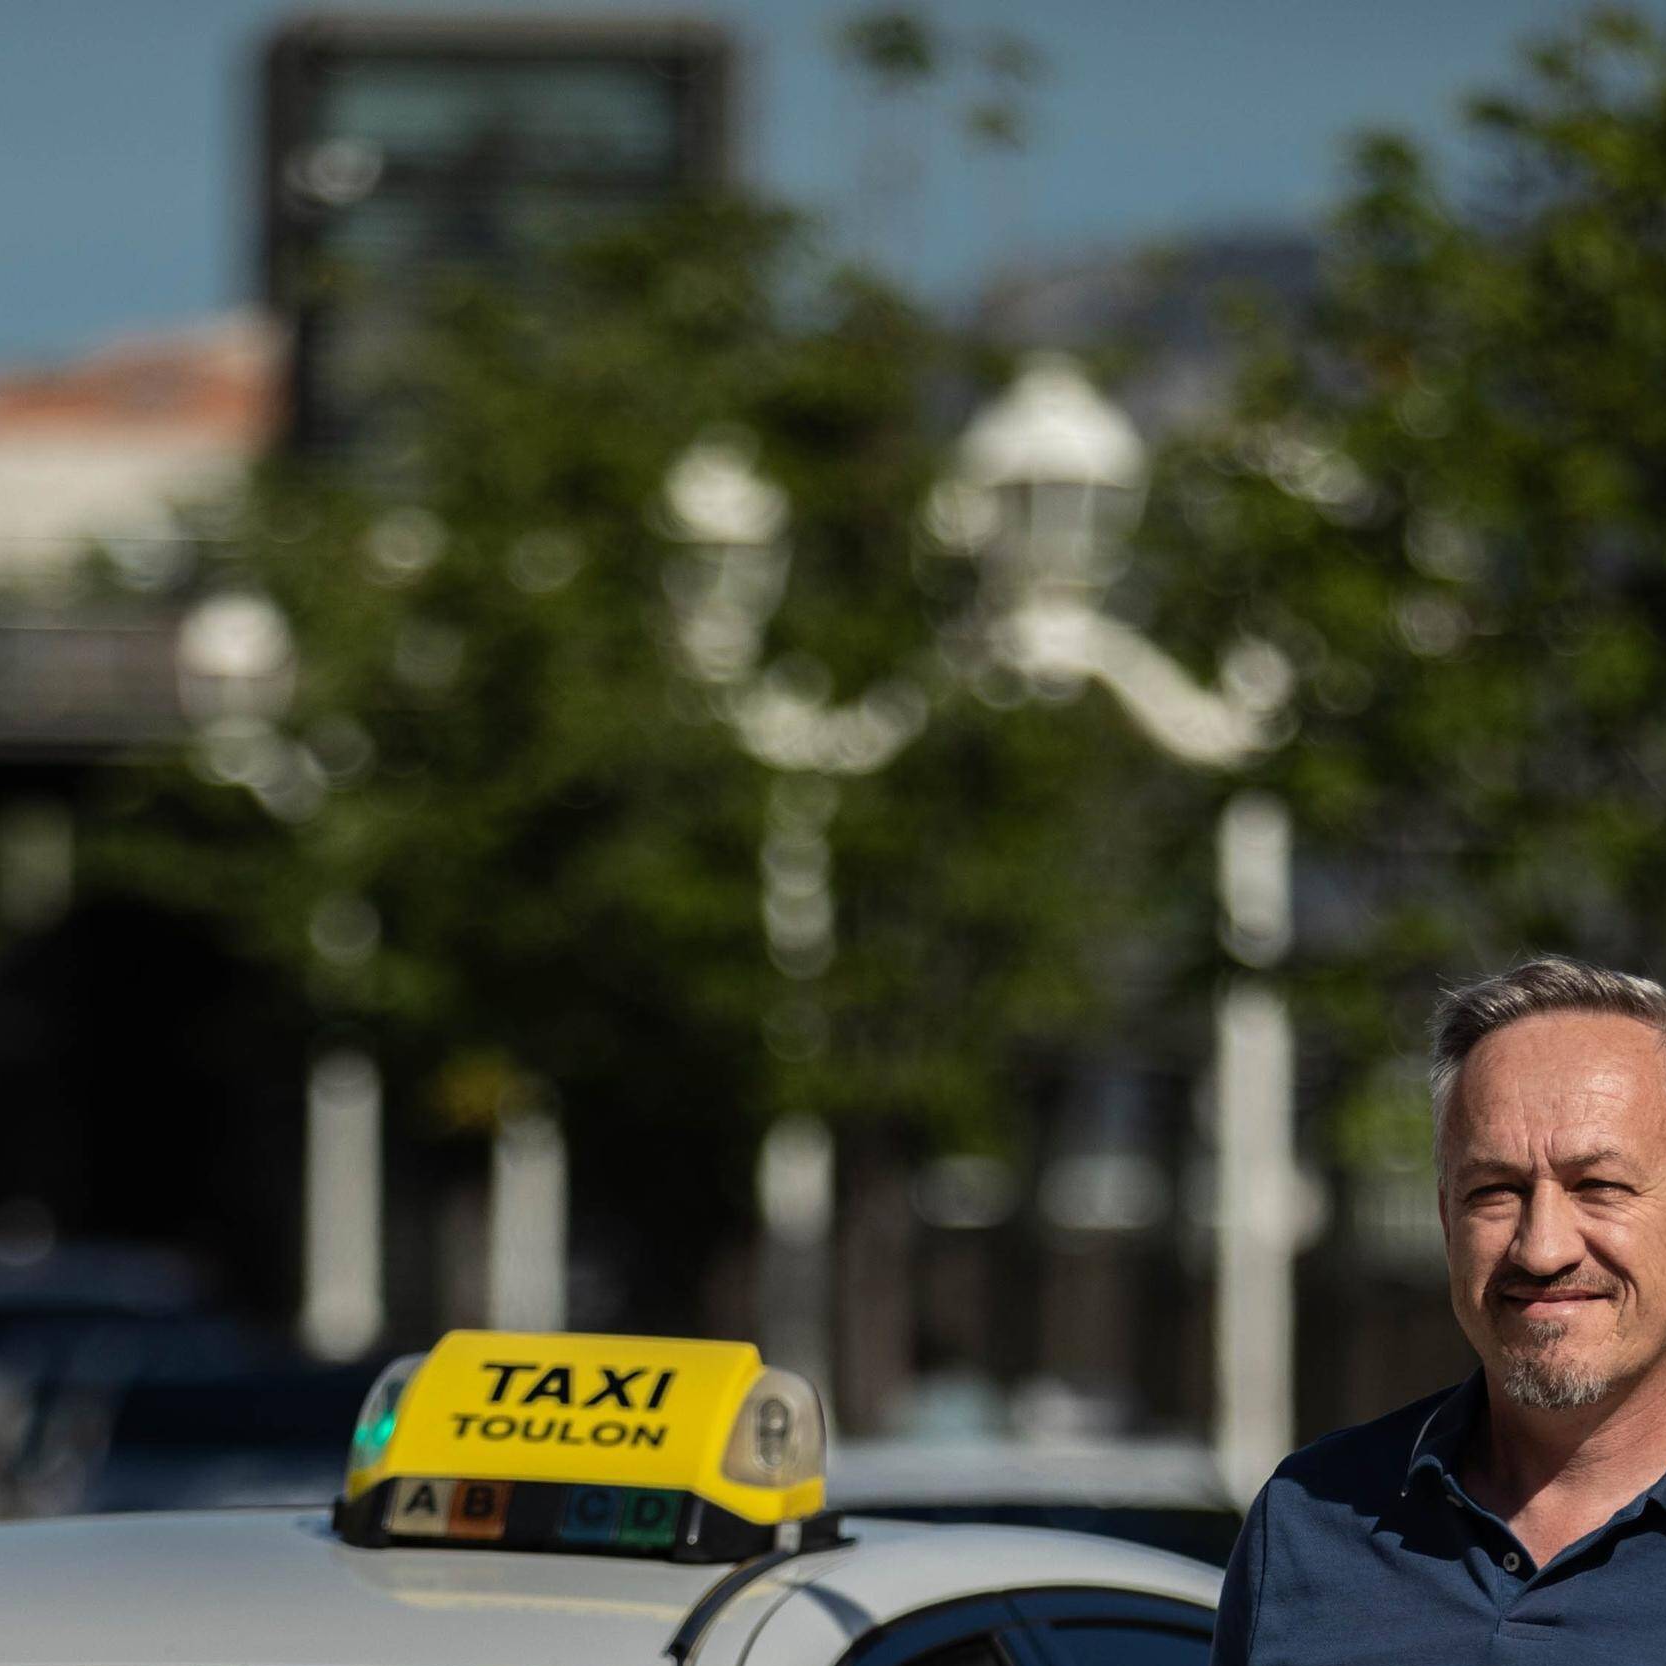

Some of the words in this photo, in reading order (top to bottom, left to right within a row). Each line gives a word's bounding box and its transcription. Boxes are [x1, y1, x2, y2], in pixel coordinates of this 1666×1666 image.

[482, 1362, 675, 1411] TAXI
[452, 1413, 667, 1449] TOULON
[404, 1484, 438, 1516] A
[463, 1486, 495, 1518] B
[577, 1490, 609, 1521] C
[634, 1495, 666, 1526] D
